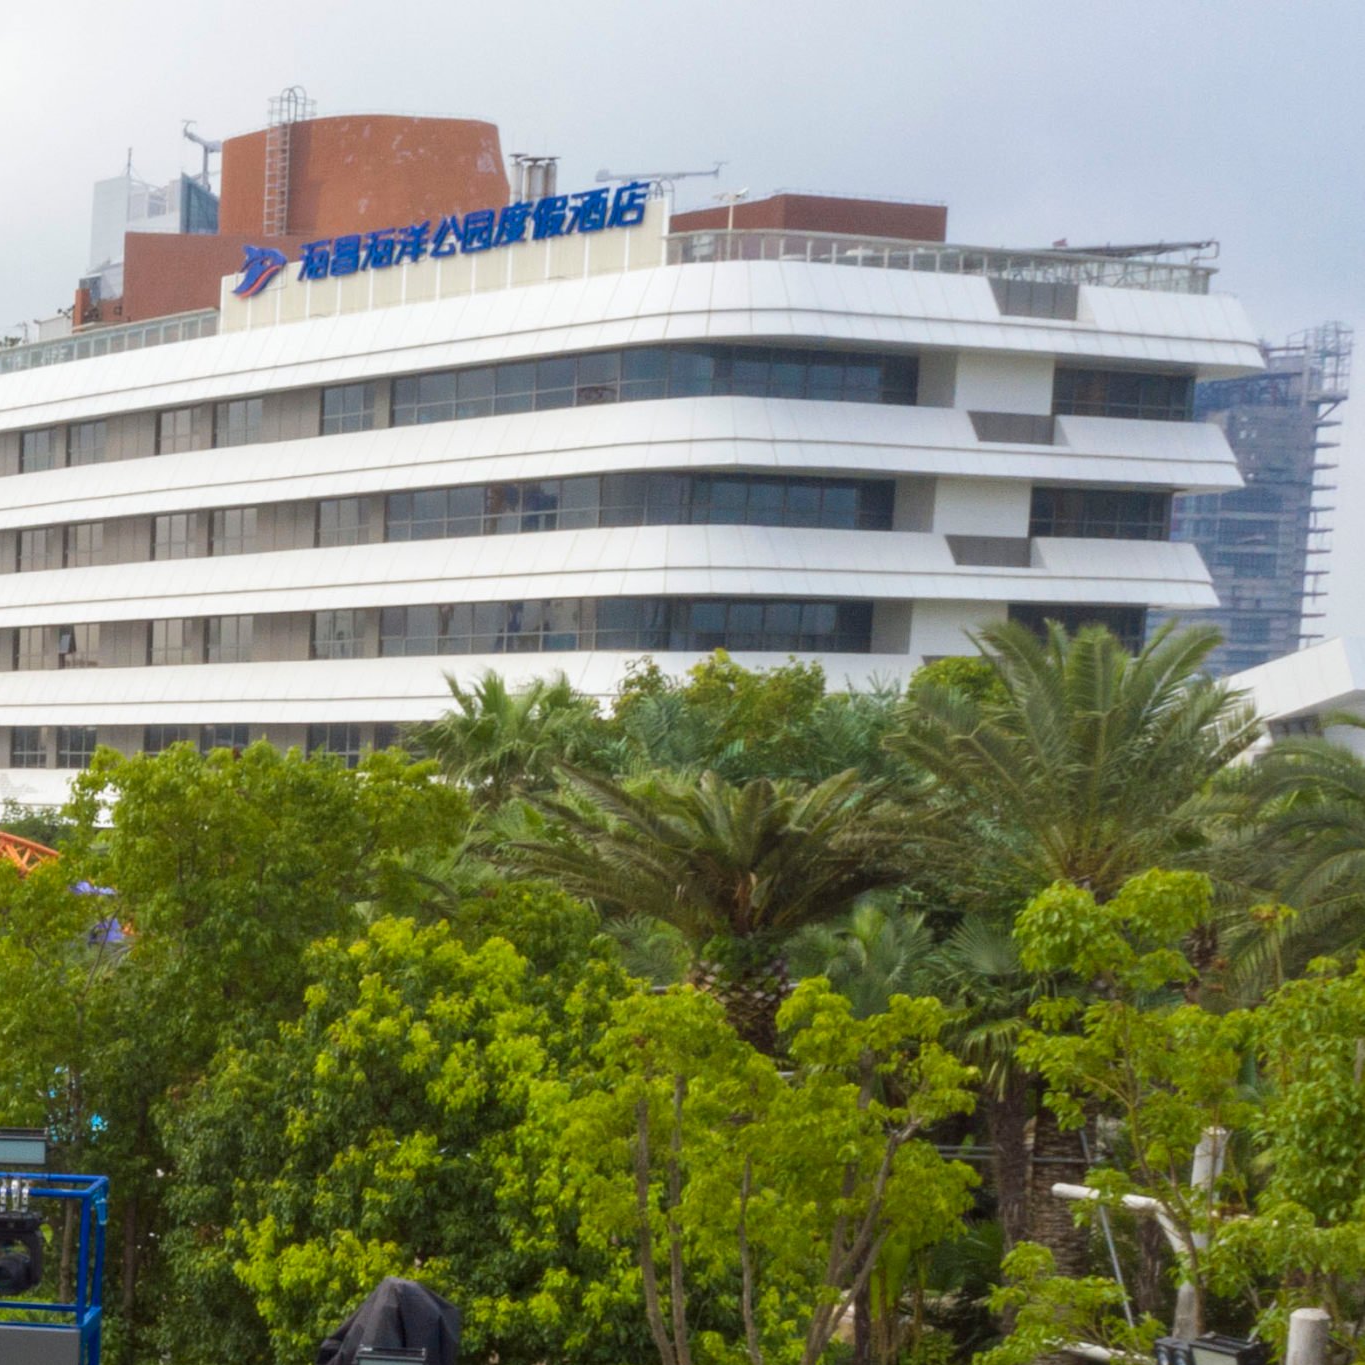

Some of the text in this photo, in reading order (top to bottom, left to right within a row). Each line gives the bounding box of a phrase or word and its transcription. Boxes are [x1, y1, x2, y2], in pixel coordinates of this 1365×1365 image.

[297, 181, 651, 282] 海昌海洋公园度假酒店
